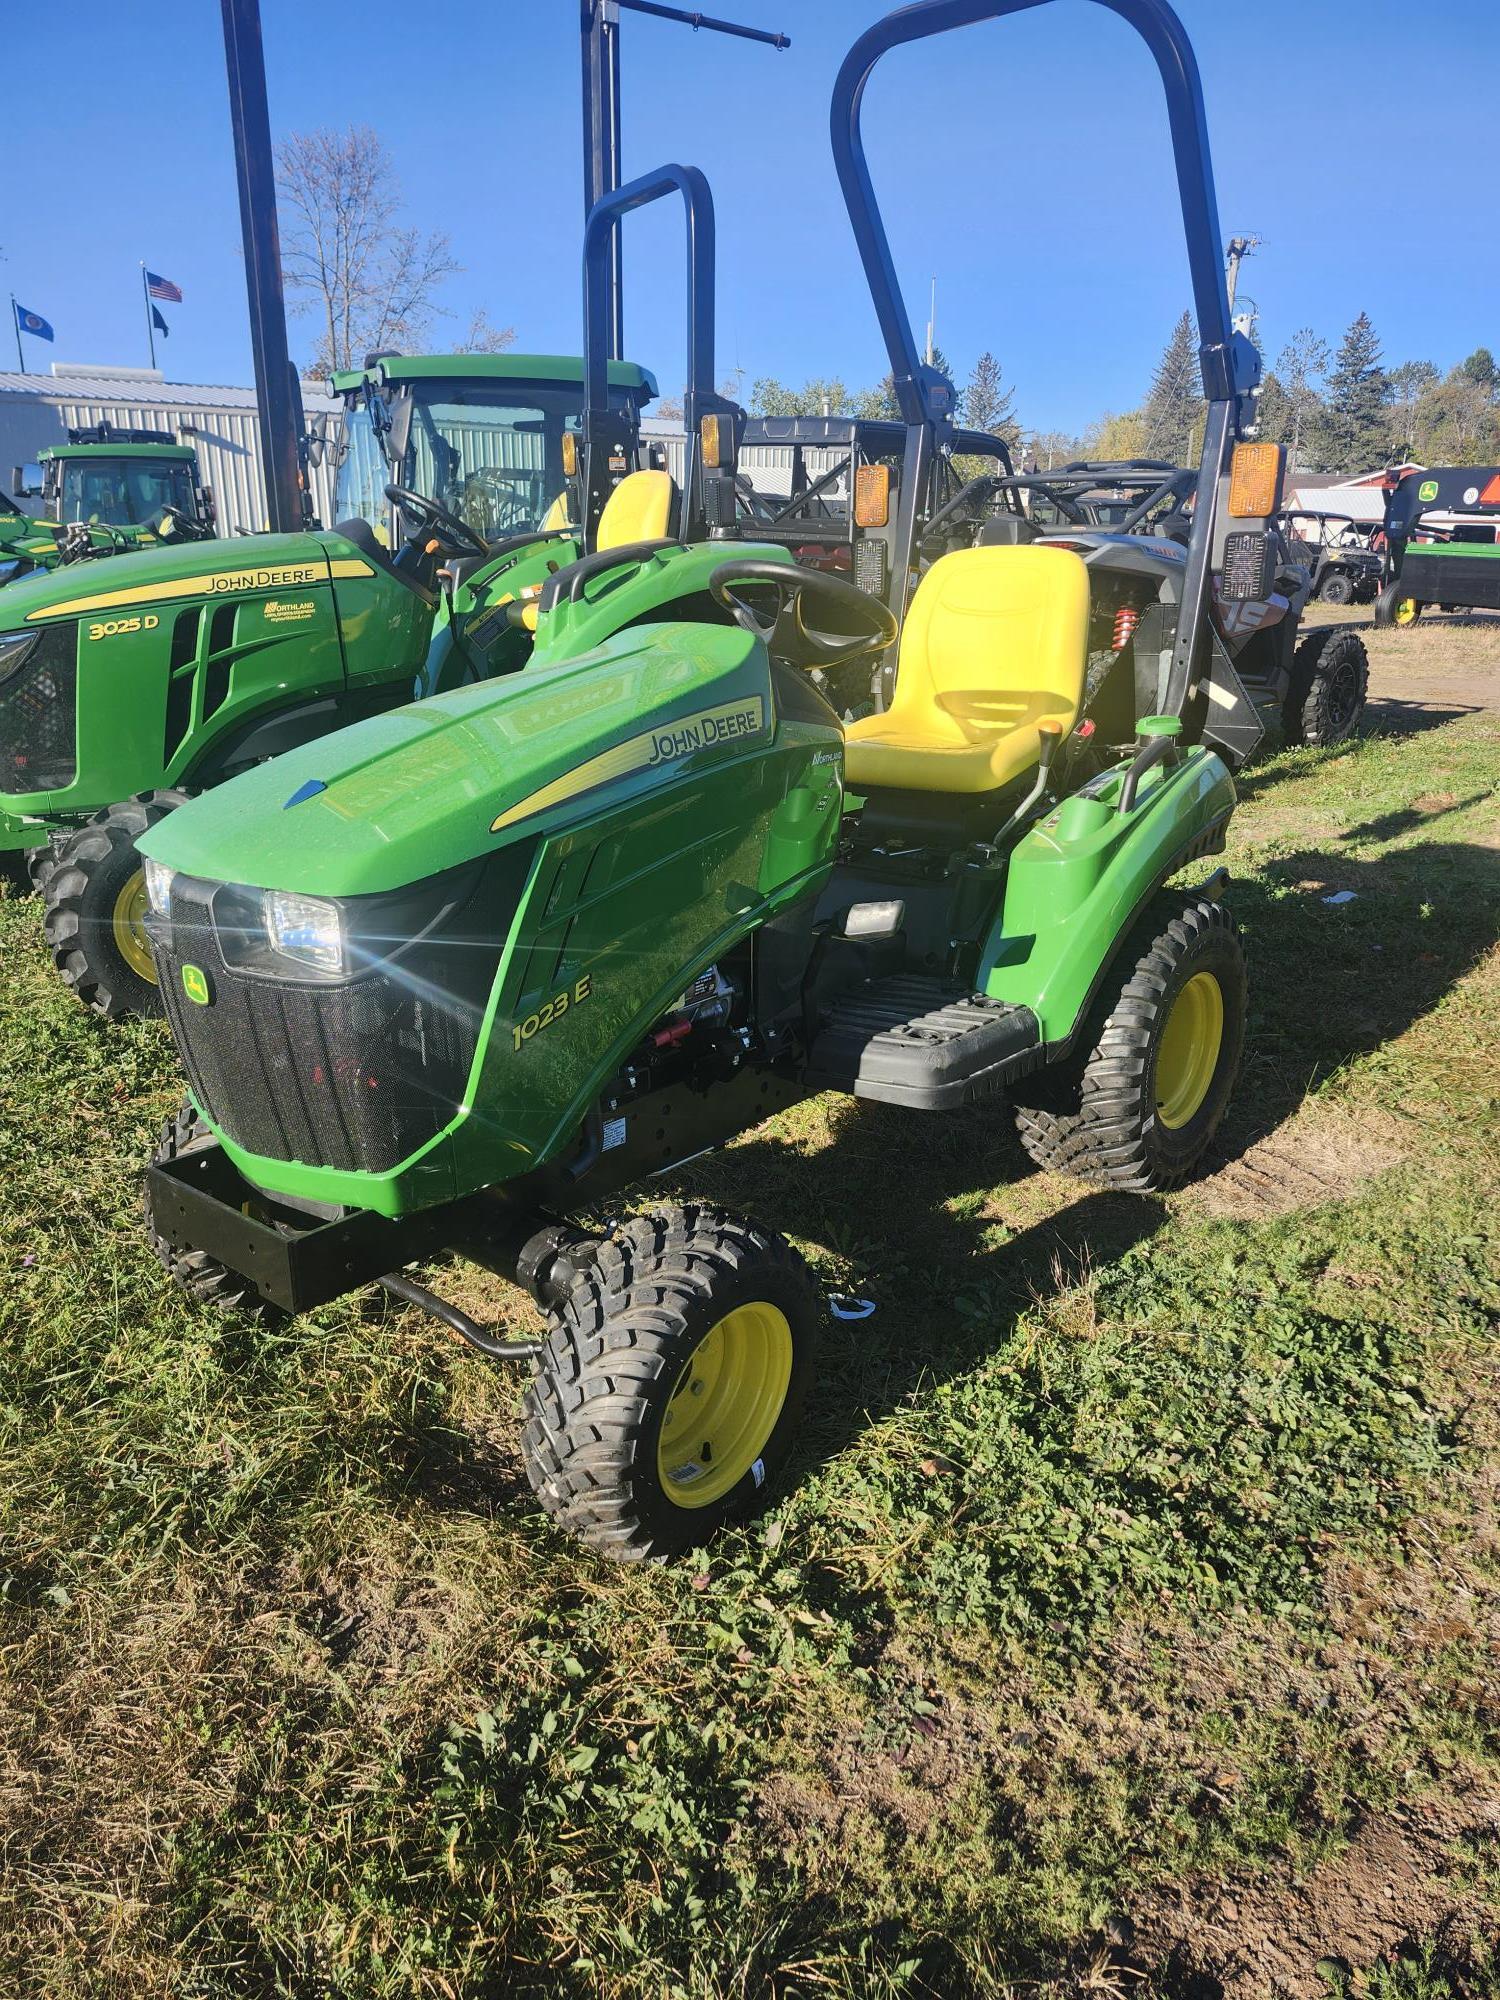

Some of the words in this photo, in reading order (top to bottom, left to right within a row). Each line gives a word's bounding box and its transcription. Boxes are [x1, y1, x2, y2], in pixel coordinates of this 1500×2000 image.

[206, 575, 254, 592] JOHN
[257, 569, 314, 586] DEERE
[264, 601, 315, 613] NORTHLAND
[88, 617, 142, 641] 3025
[144, 615, 159, 629] D
[649, 726, 701, 763] JOHN
[701, 711, 758, 742] DEERE
[512, 992, 570, 1053] 1023
[574, 973, 592, 1005] E
